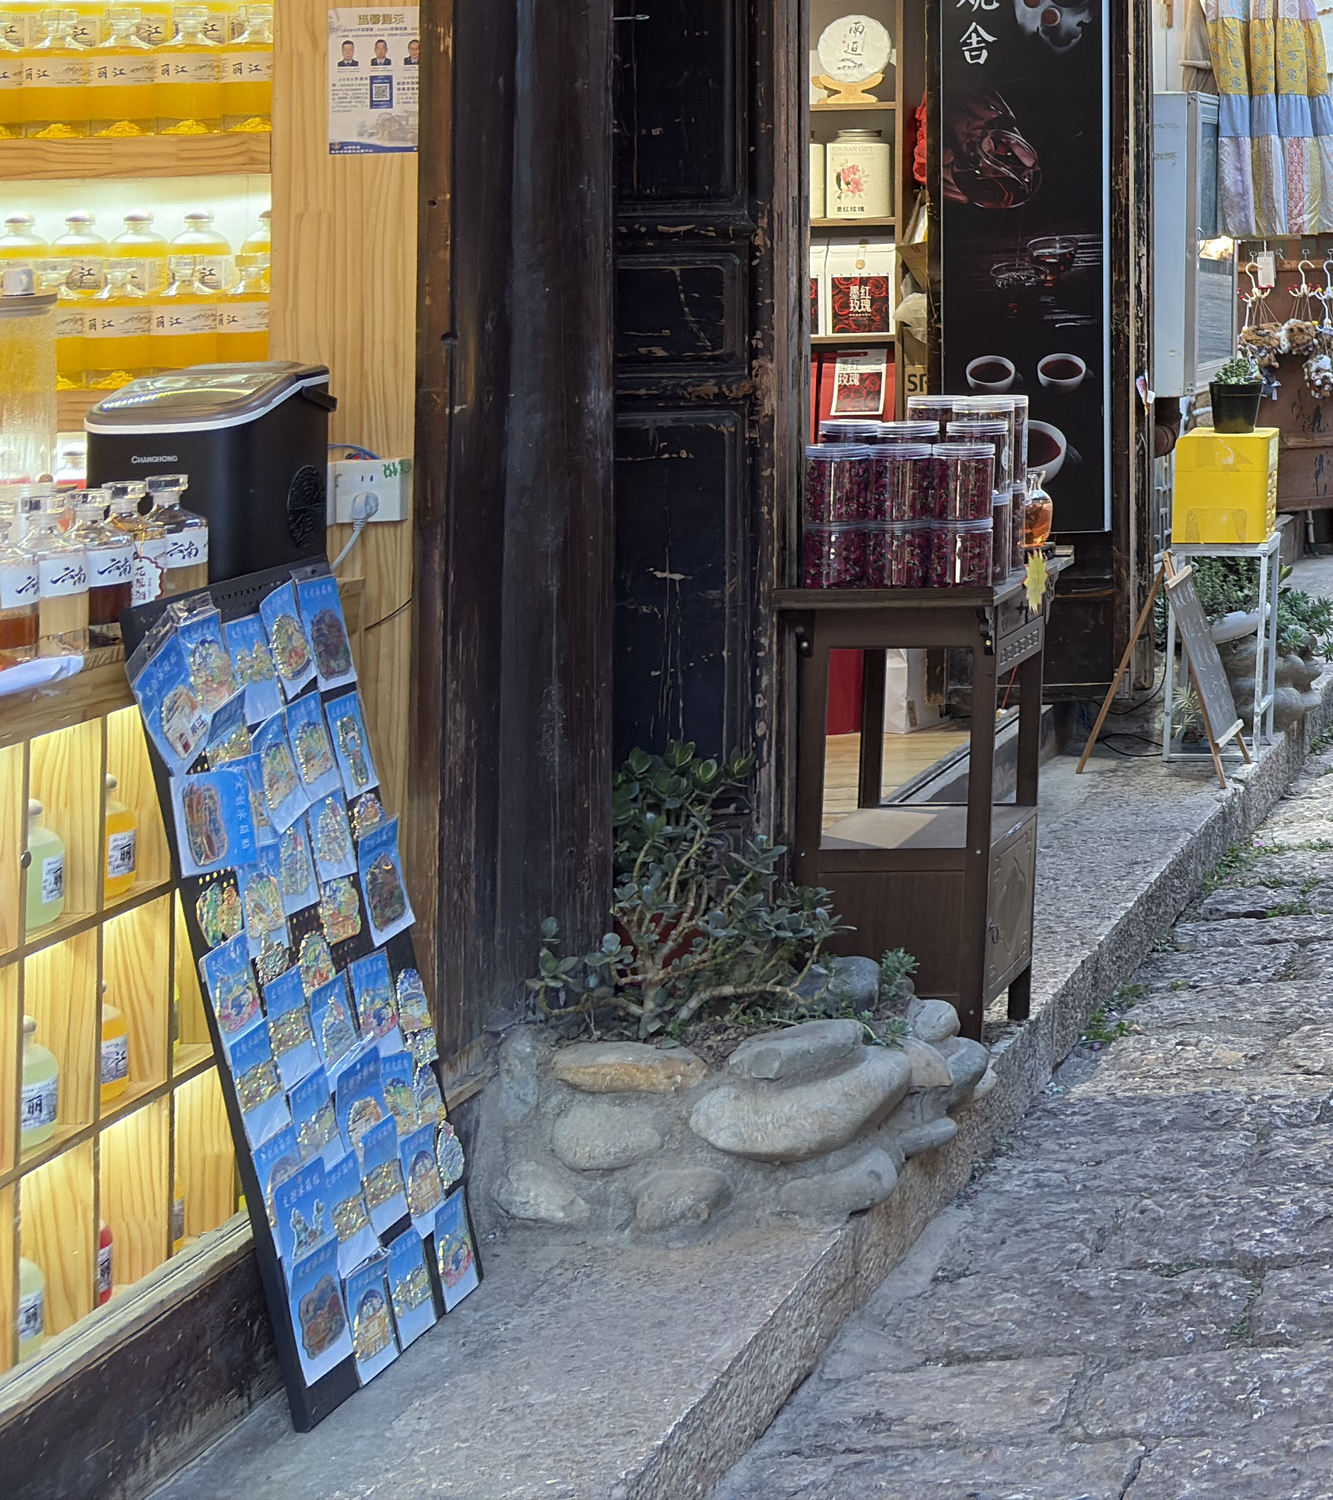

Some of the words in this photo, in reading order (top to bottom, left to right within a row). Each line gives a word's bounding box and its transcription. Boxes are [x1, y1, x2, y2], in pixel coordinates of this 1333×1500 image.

[850, 286, 871, 300] 墨红
[850, 300, 871, 313] 玫瑰
[838, 372, 860, 386] 玫瑰
